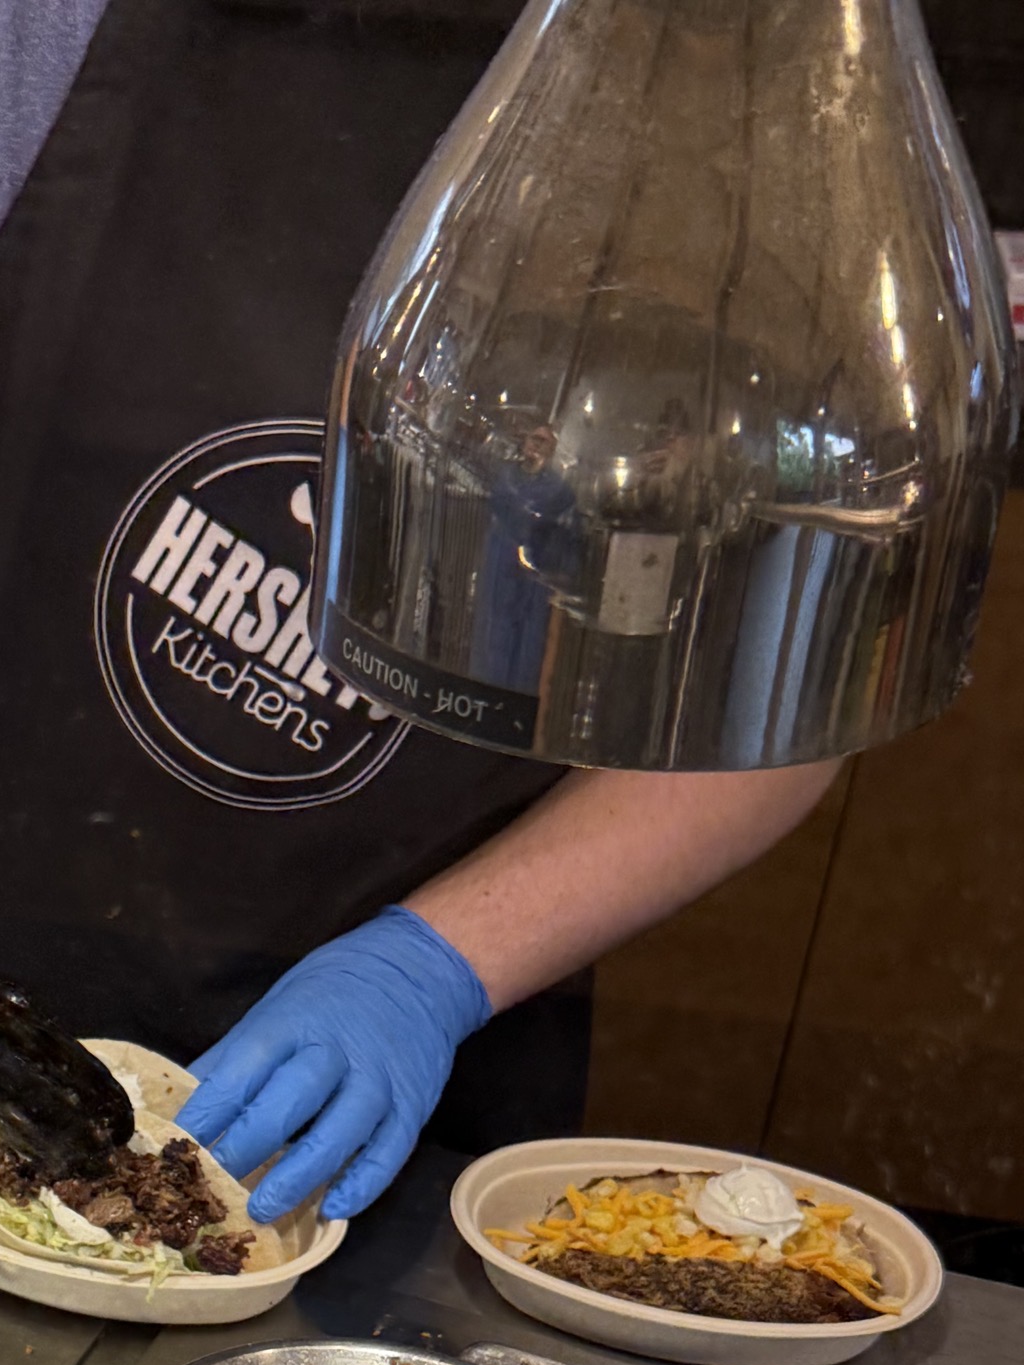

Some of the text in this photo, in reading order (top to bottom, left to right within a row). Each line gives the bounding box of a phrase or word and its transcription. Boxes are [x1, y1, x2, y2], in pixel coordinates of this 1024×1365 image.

[151, 616, 330, 751] Kitchens
[342, 637, 419, 699] CAUTION
[436, 687, 489, 723] HOT
